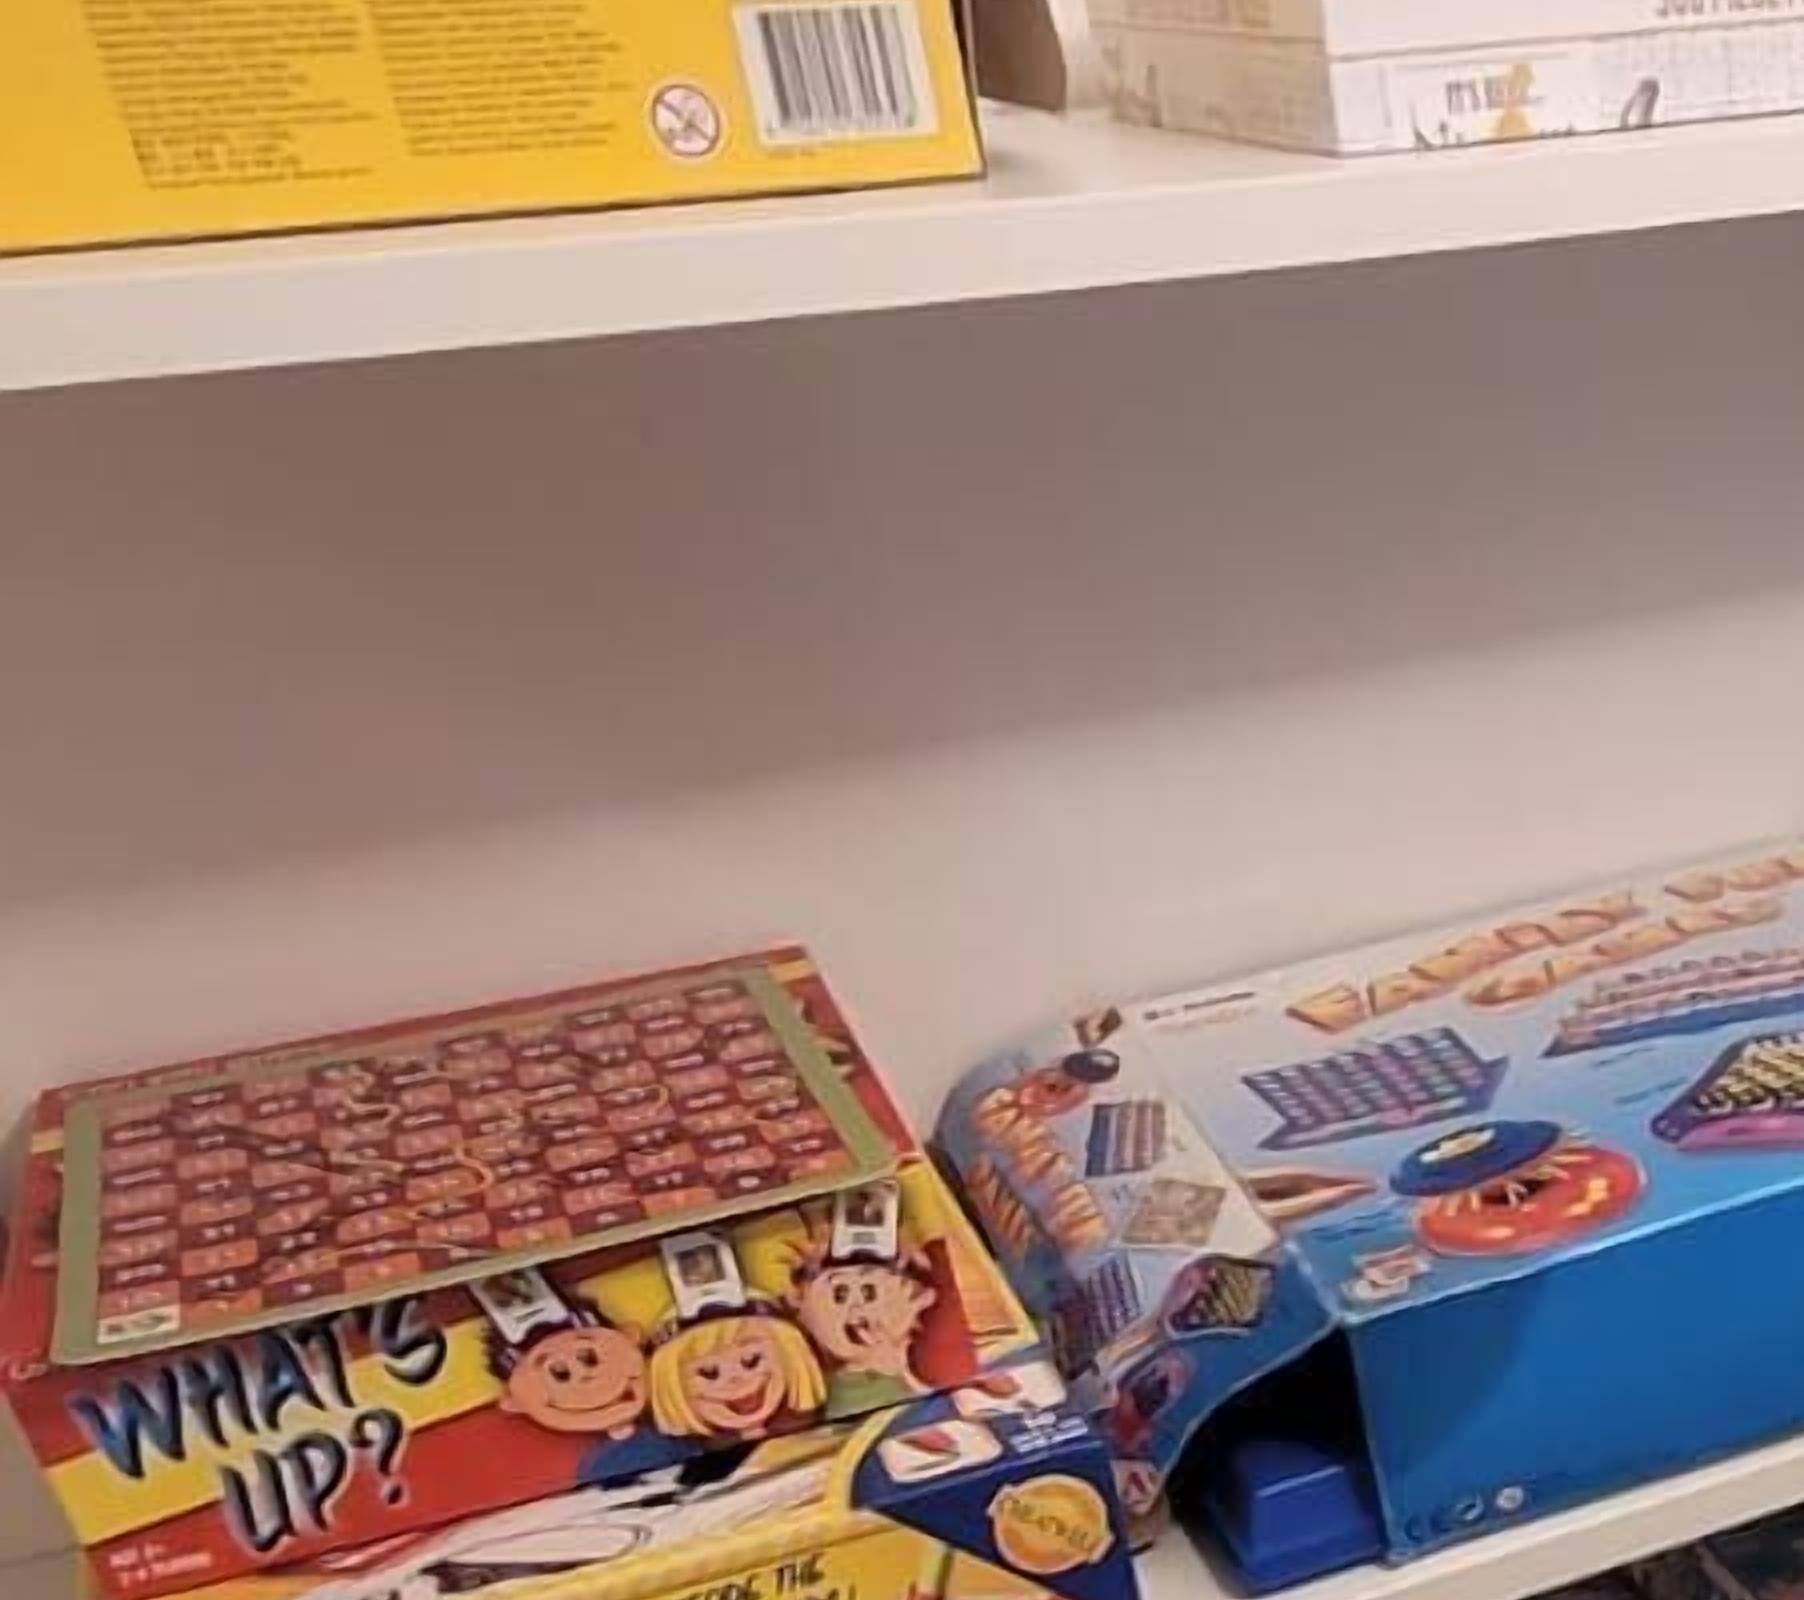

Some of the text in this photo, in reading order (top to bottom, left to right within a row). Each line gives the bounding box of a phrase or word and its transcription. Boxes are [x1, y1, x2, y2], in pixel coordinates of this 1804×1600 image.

[73, 1298, 448, 1479] WHAT'S
[220, 1407, 404, 1552] UP?
[774, 1551, 827, 1597] THE
